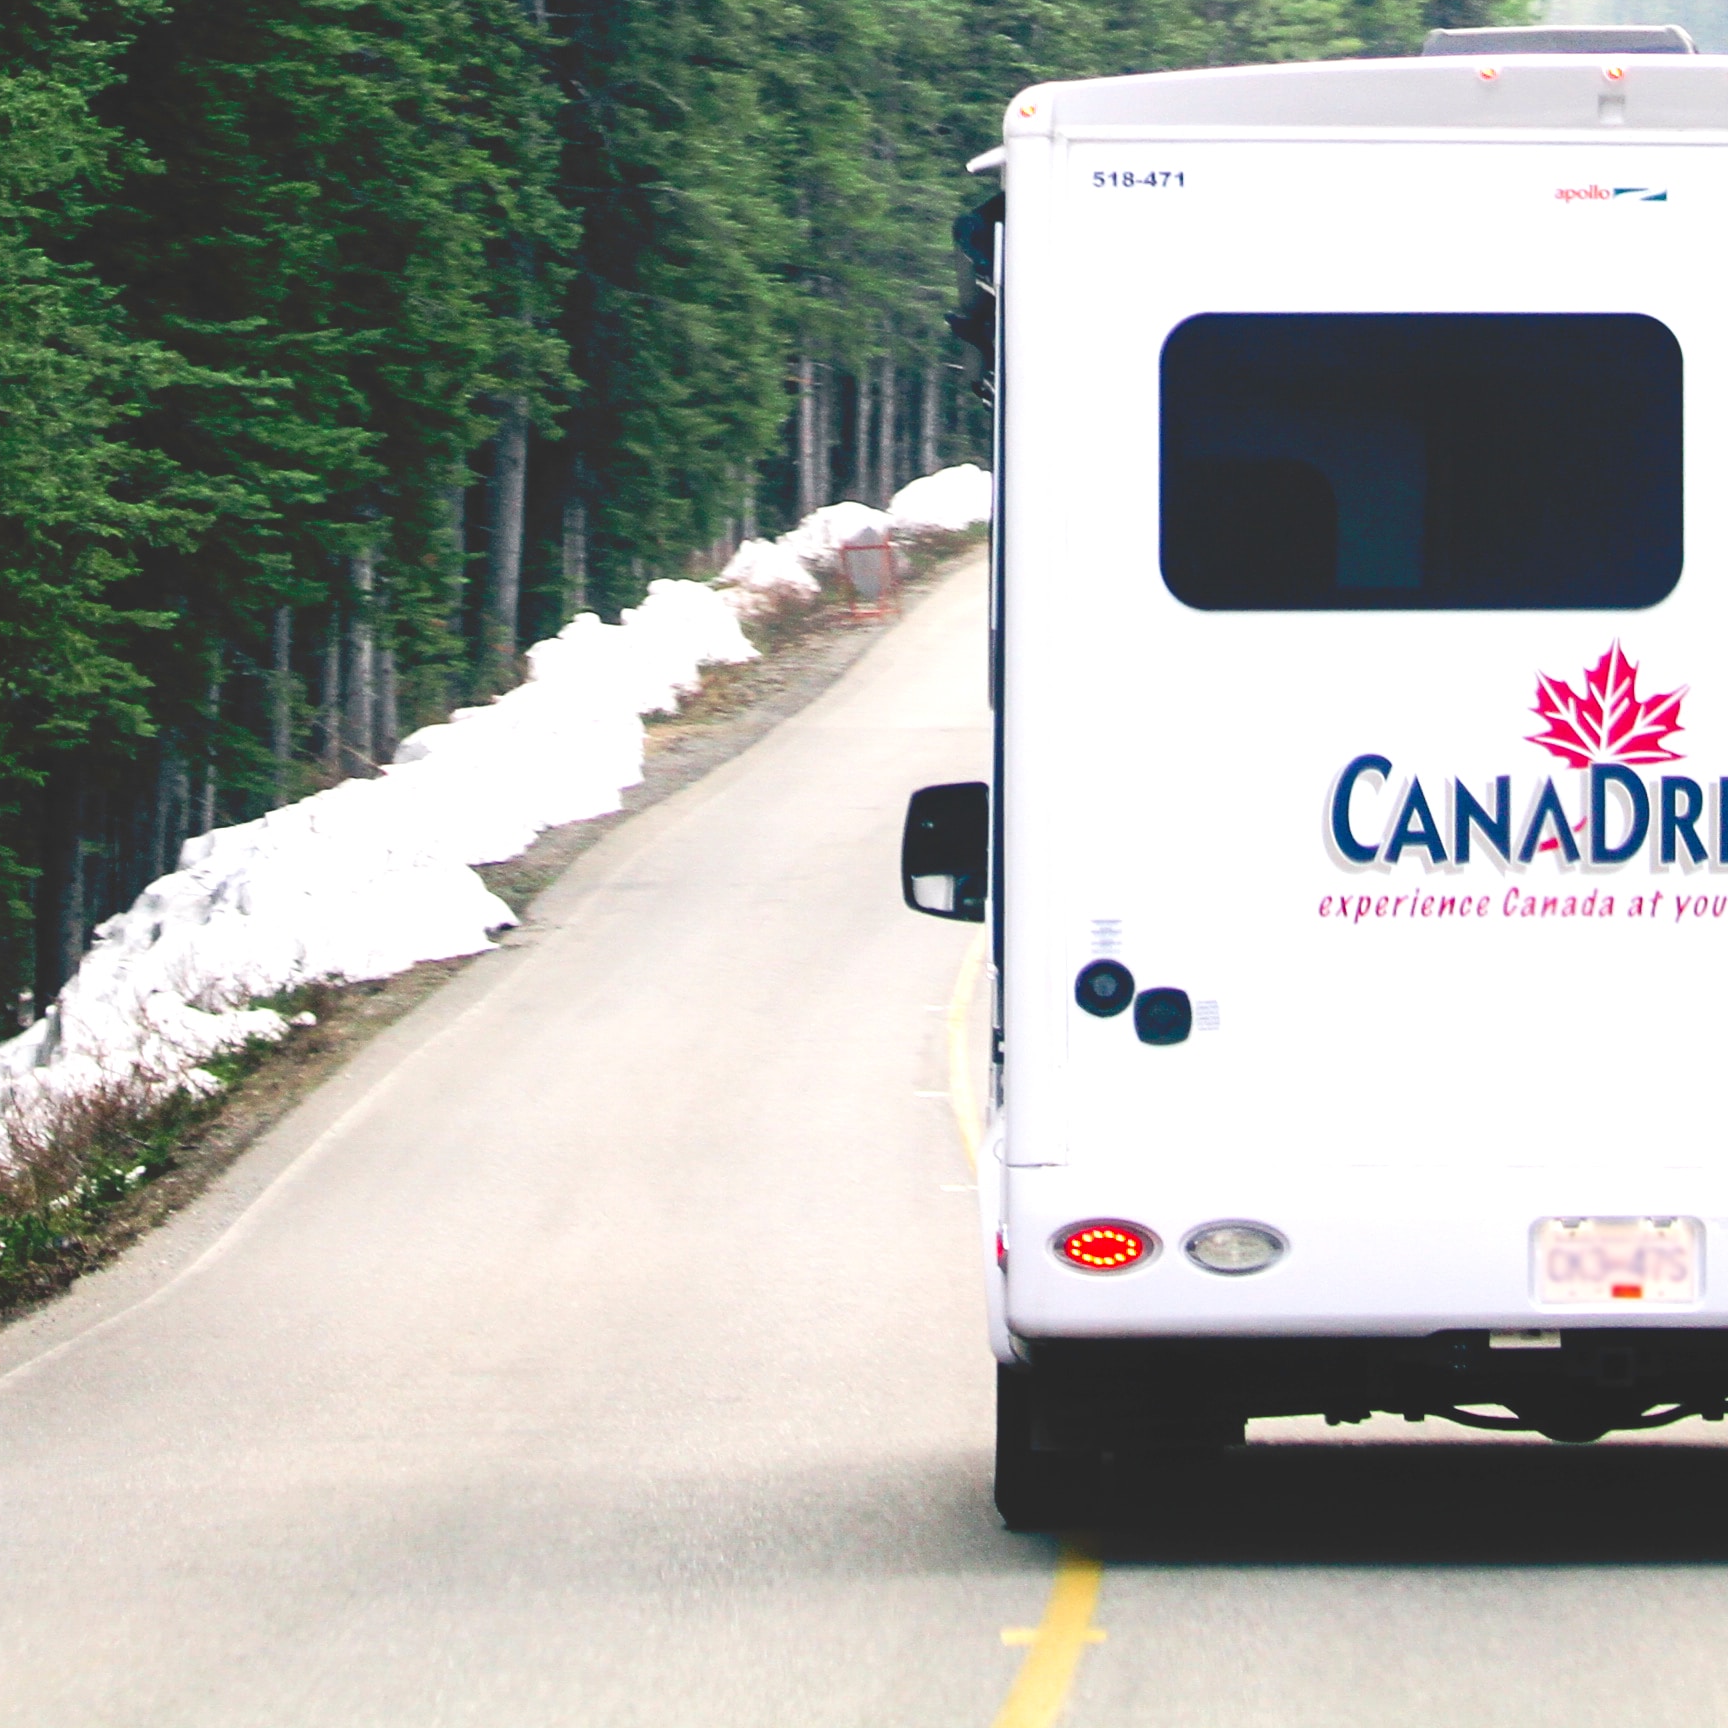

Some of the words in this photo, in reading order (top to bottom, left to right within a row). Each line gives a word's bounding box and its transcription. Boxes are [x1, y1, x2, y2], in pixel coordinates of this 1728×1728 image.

[1092, 170, 1186, 189] 518-471
[1554, 184, 1611, 204] apollo
[1317, 887, 1492, 926] experience
[1501, 885, 1616, 919] Canada
[1626, 889, 1665, 919] at
